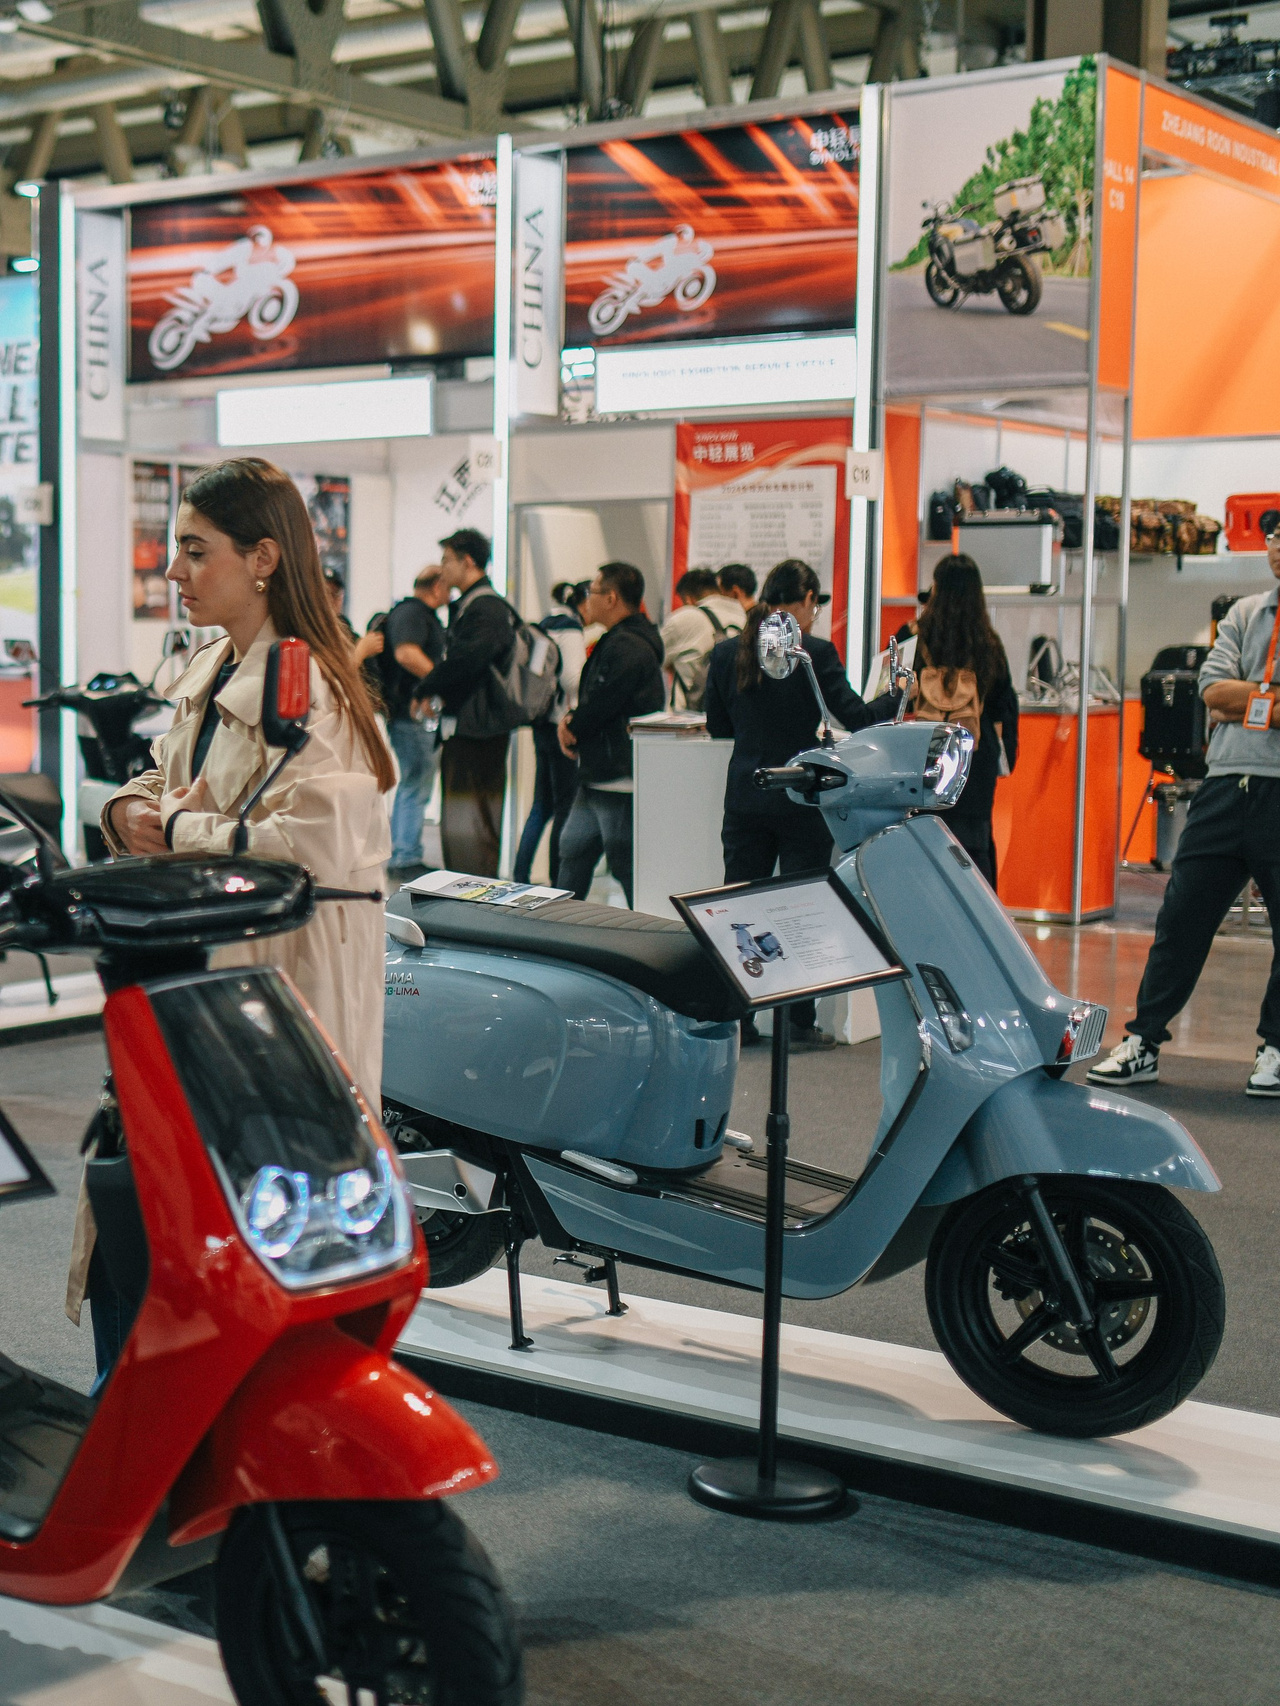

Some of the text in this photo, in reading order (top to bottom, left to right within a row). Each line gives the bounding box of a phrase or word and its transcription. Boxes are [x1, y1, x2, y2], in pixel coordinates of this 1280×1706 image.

[86, 258, 110, 400] CHINA
[523, 208, 544, 369] CHINA
[384, 972, 415, 985] LIMA
